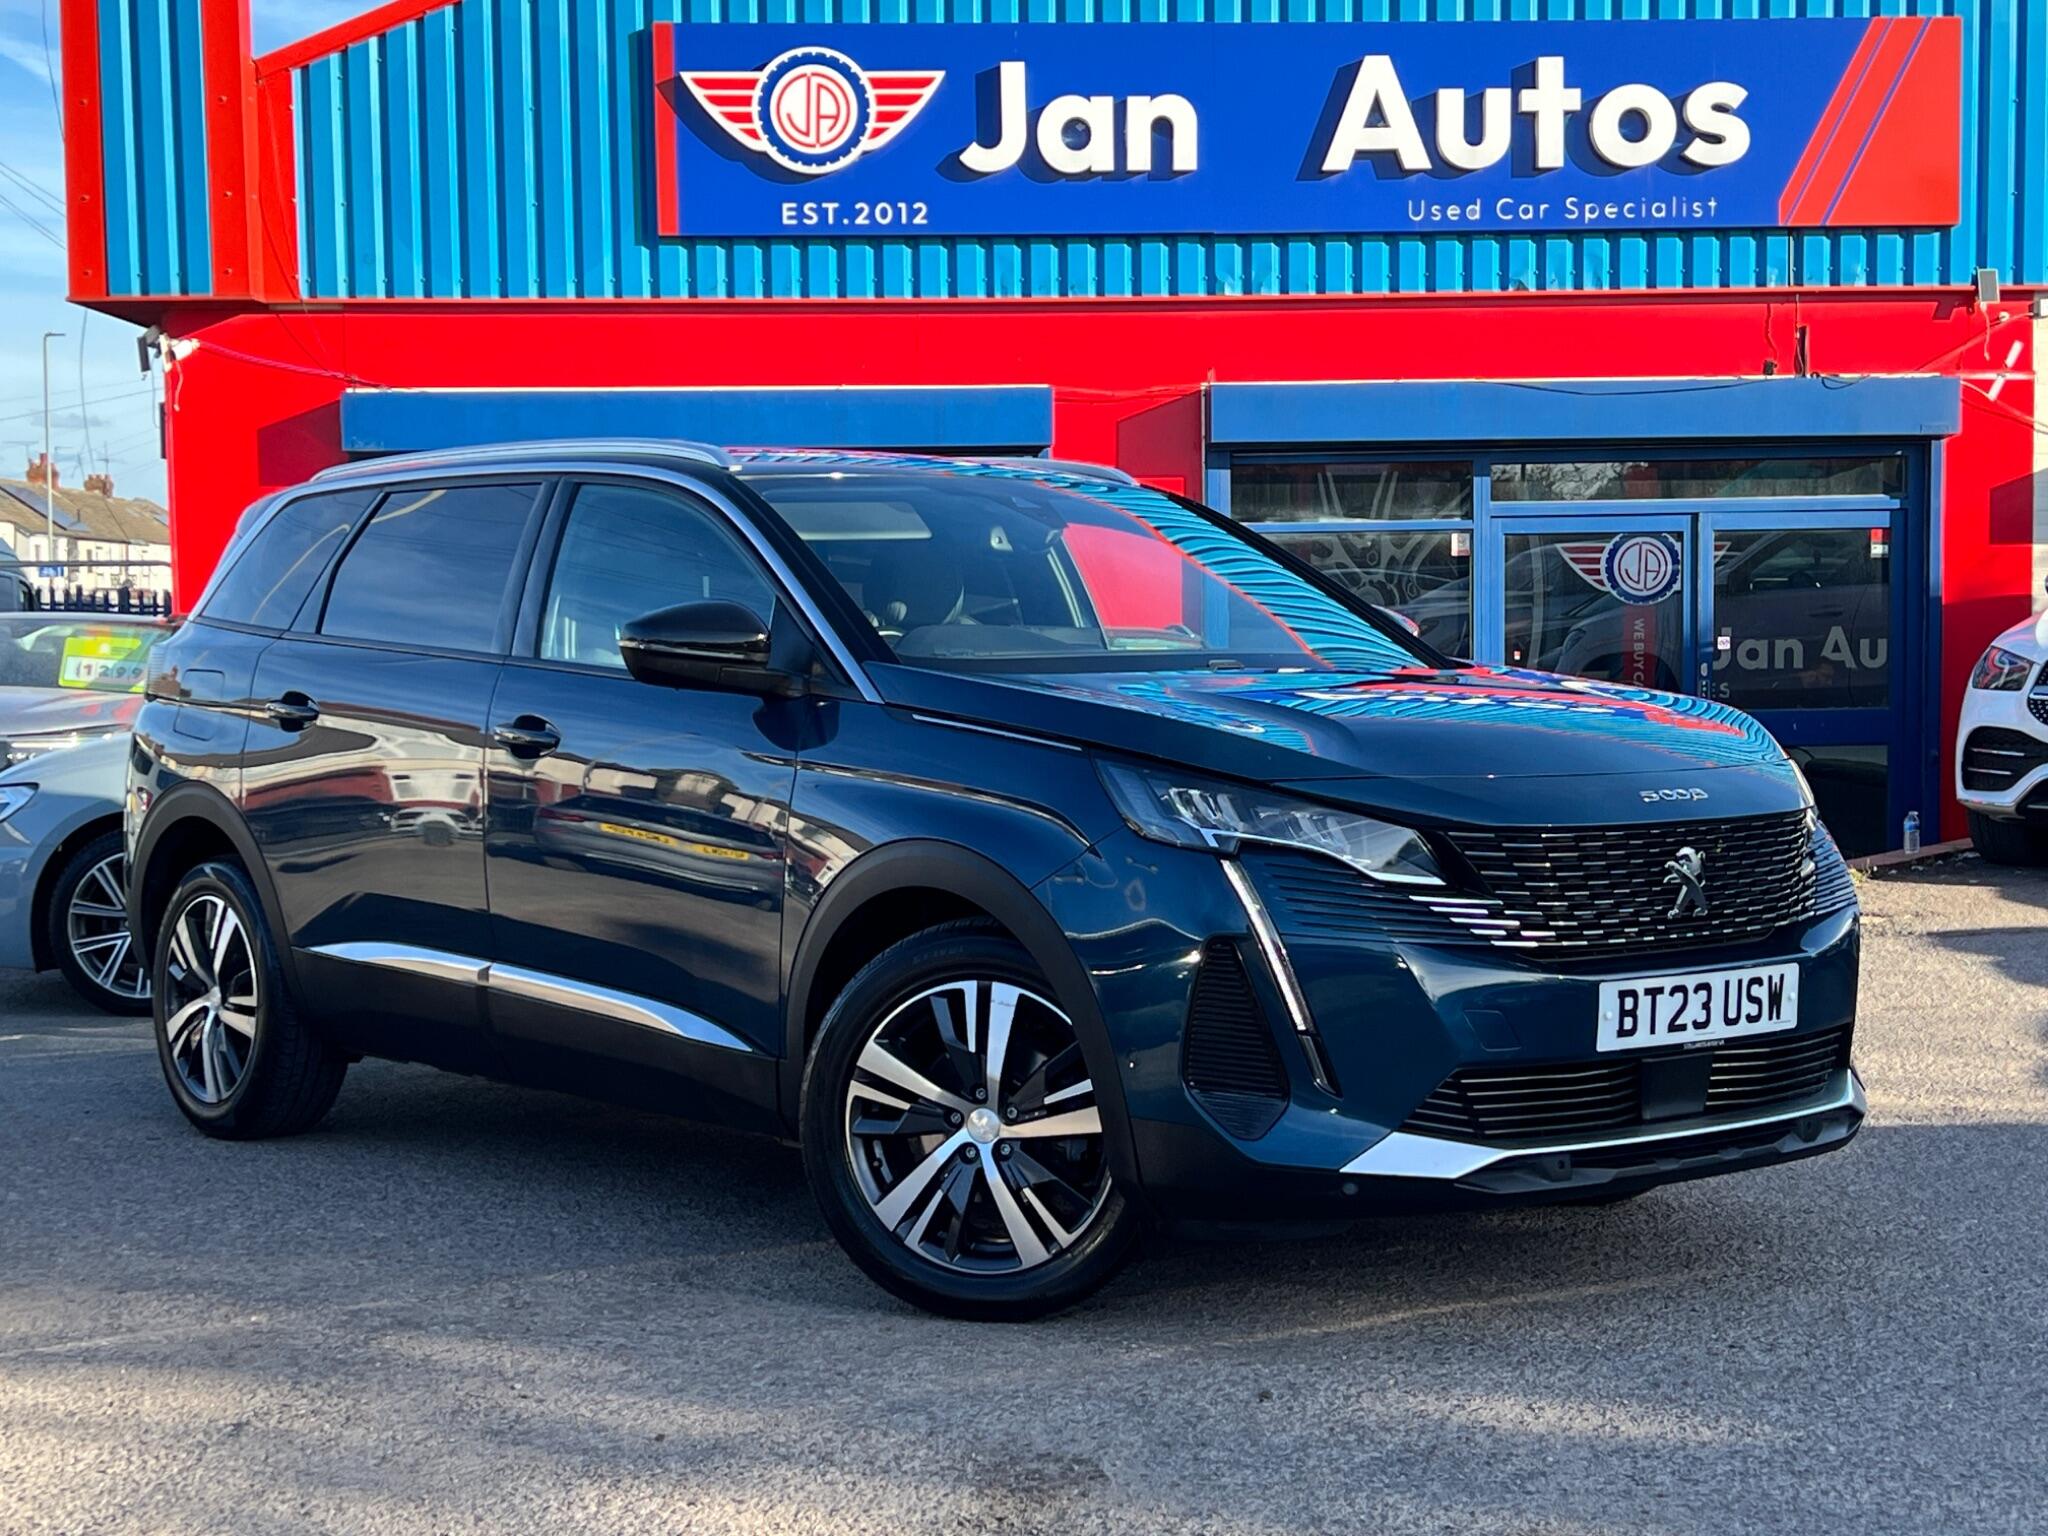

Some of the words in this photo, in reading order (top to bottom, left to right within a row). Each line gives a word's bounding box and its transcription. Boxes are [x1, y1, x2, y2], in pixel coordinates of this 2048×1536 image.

[958, 61, 1198, 174] Jan
[1321, 54, 1751, 171] Autos
[782, 202, 928, 225] EST.2012
[1408, 198, 1481, 222] Used
[1495, 197, 1549, 221] Car
[1564, 196, 1718, 224] Specialist
[1633, 619, 1645, 638] WE
[1633, 643, 1645, 668] BUY
[1712, 627, 1804, 670] Jan
[1616, 982, 1713, 1039] BT23
[1723, 973, 1785, 1027] USW
